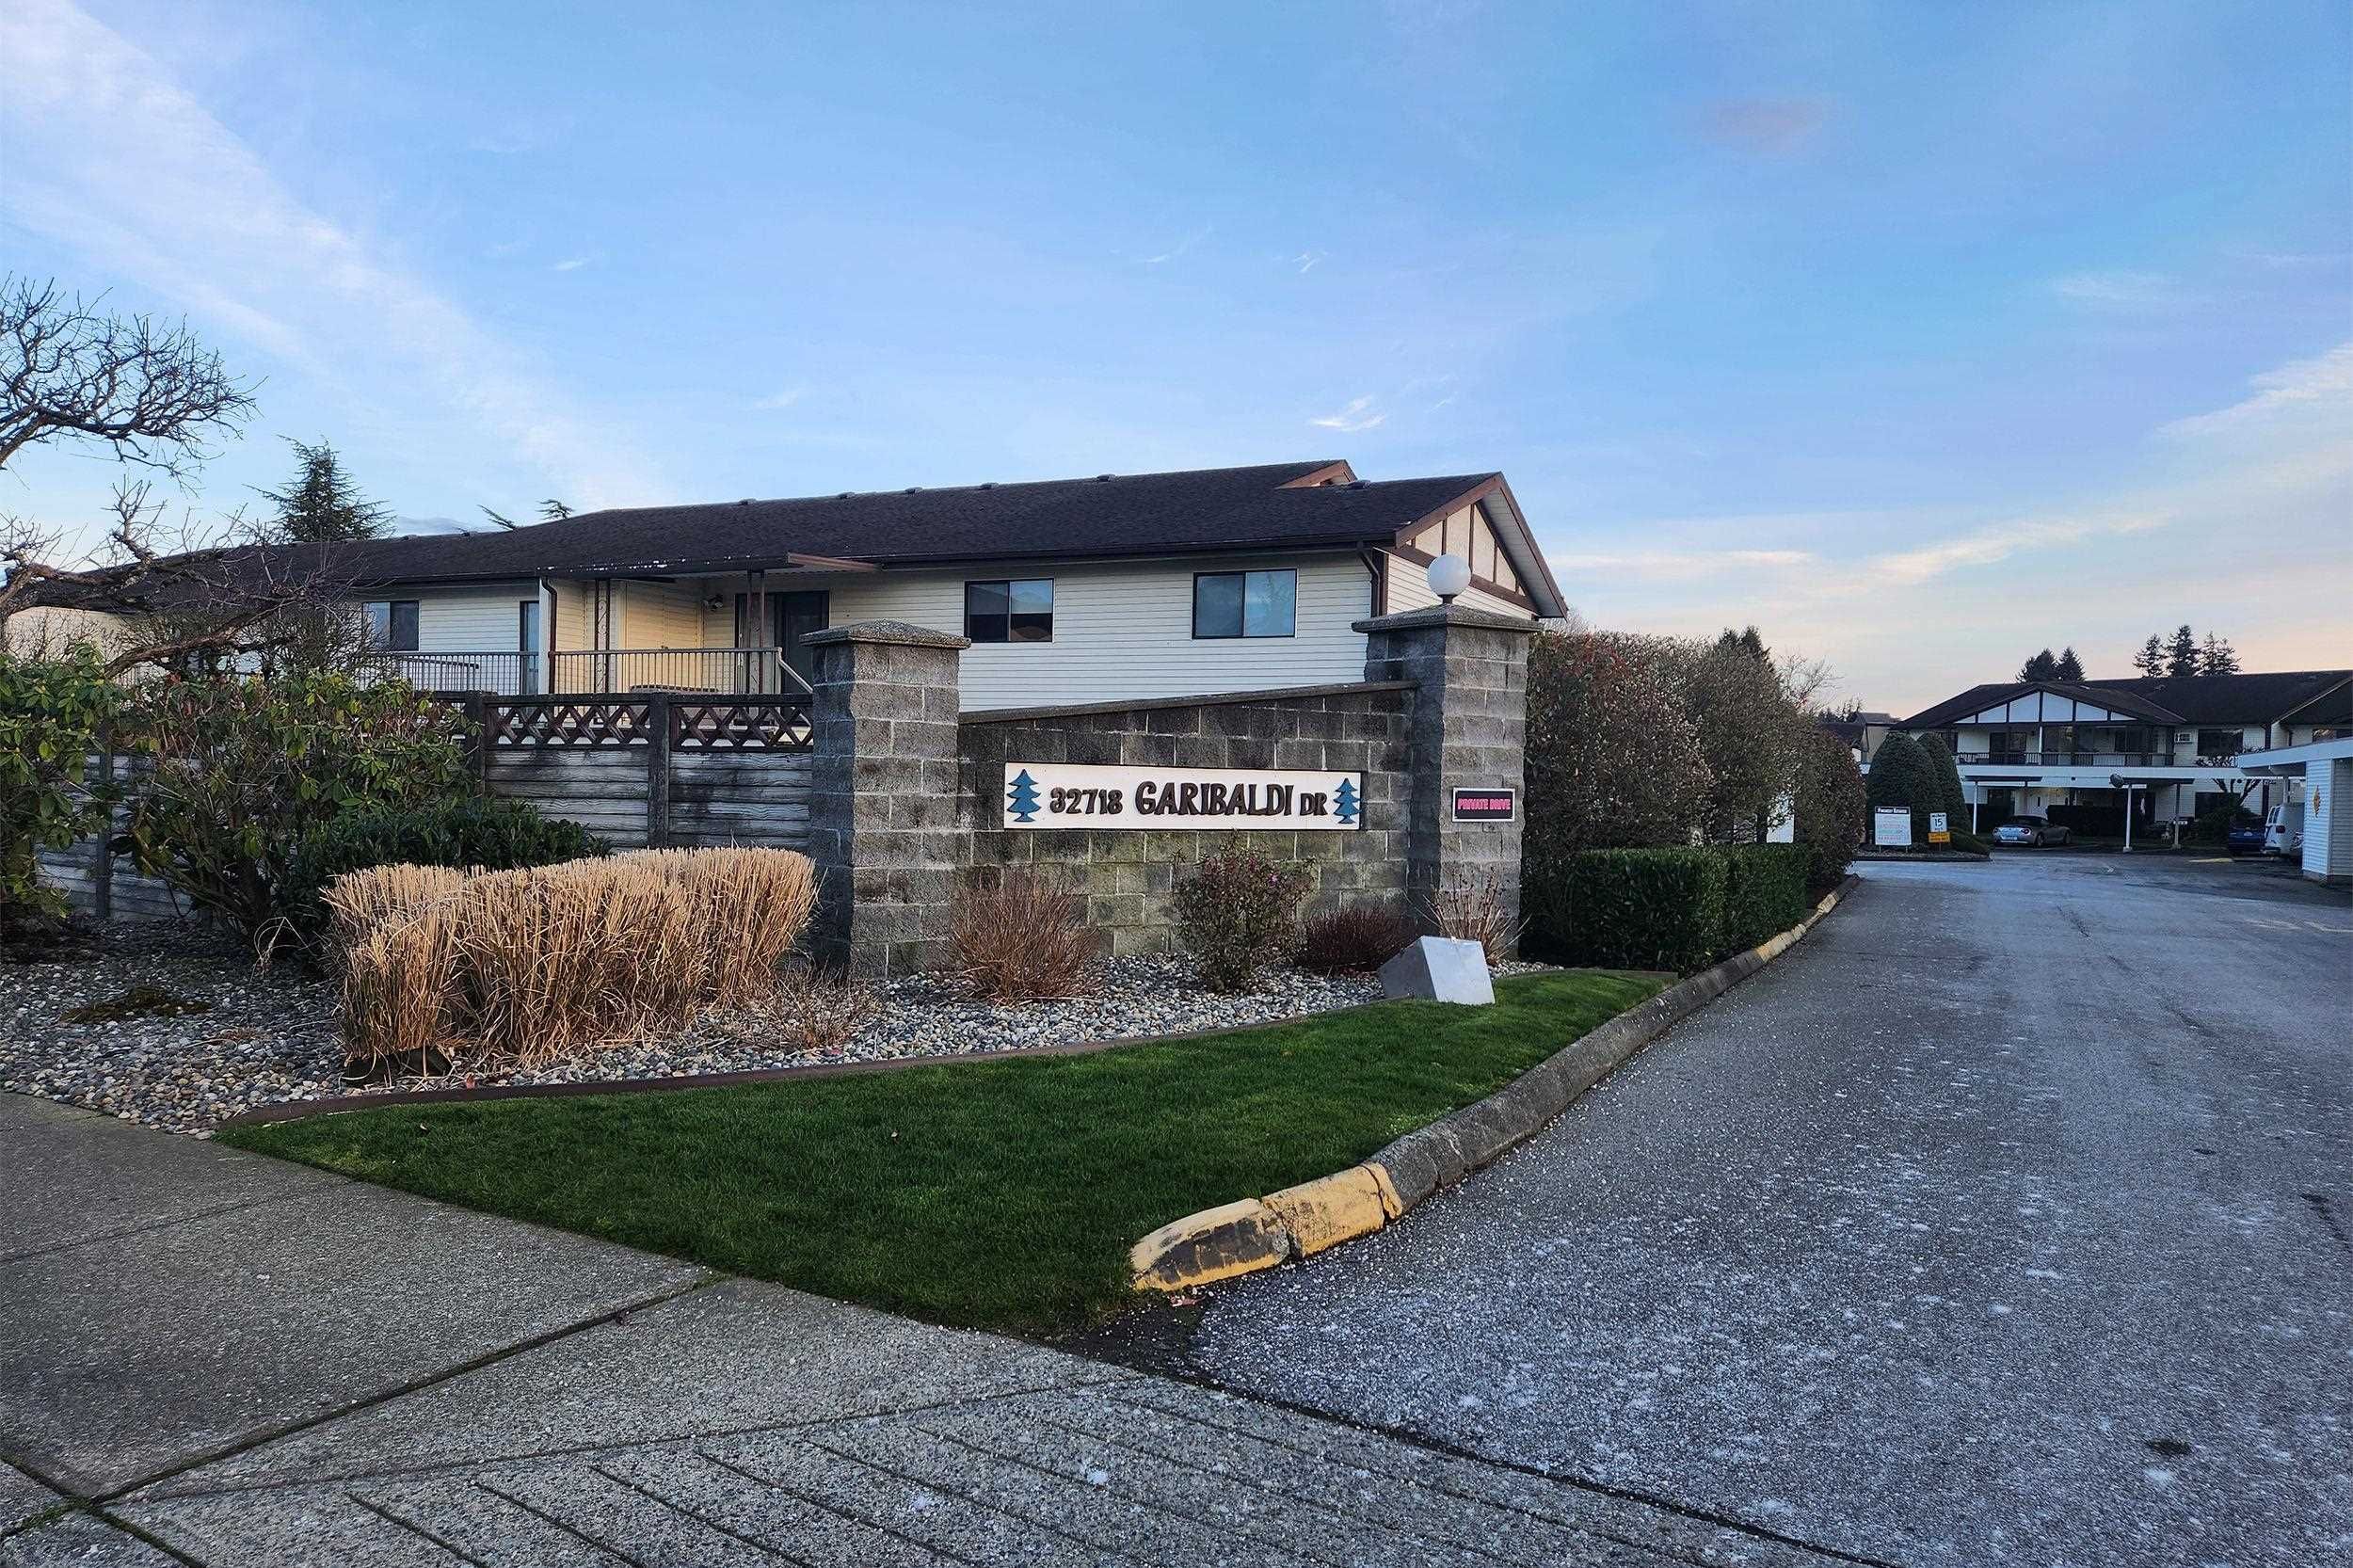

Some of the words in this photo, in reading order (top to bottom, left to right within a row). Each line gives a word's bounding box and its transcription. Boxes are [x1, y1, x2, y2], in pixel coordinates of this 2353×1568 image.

[1049, 787, 1123, 814] 32718
[1136, 781, 1293, 816] GARIBALDI
[1300, 793, 1328, 816] DR
[1457, 798, 1489, 810] PRIVATE
[1934, 818, 1944, 827] 15
